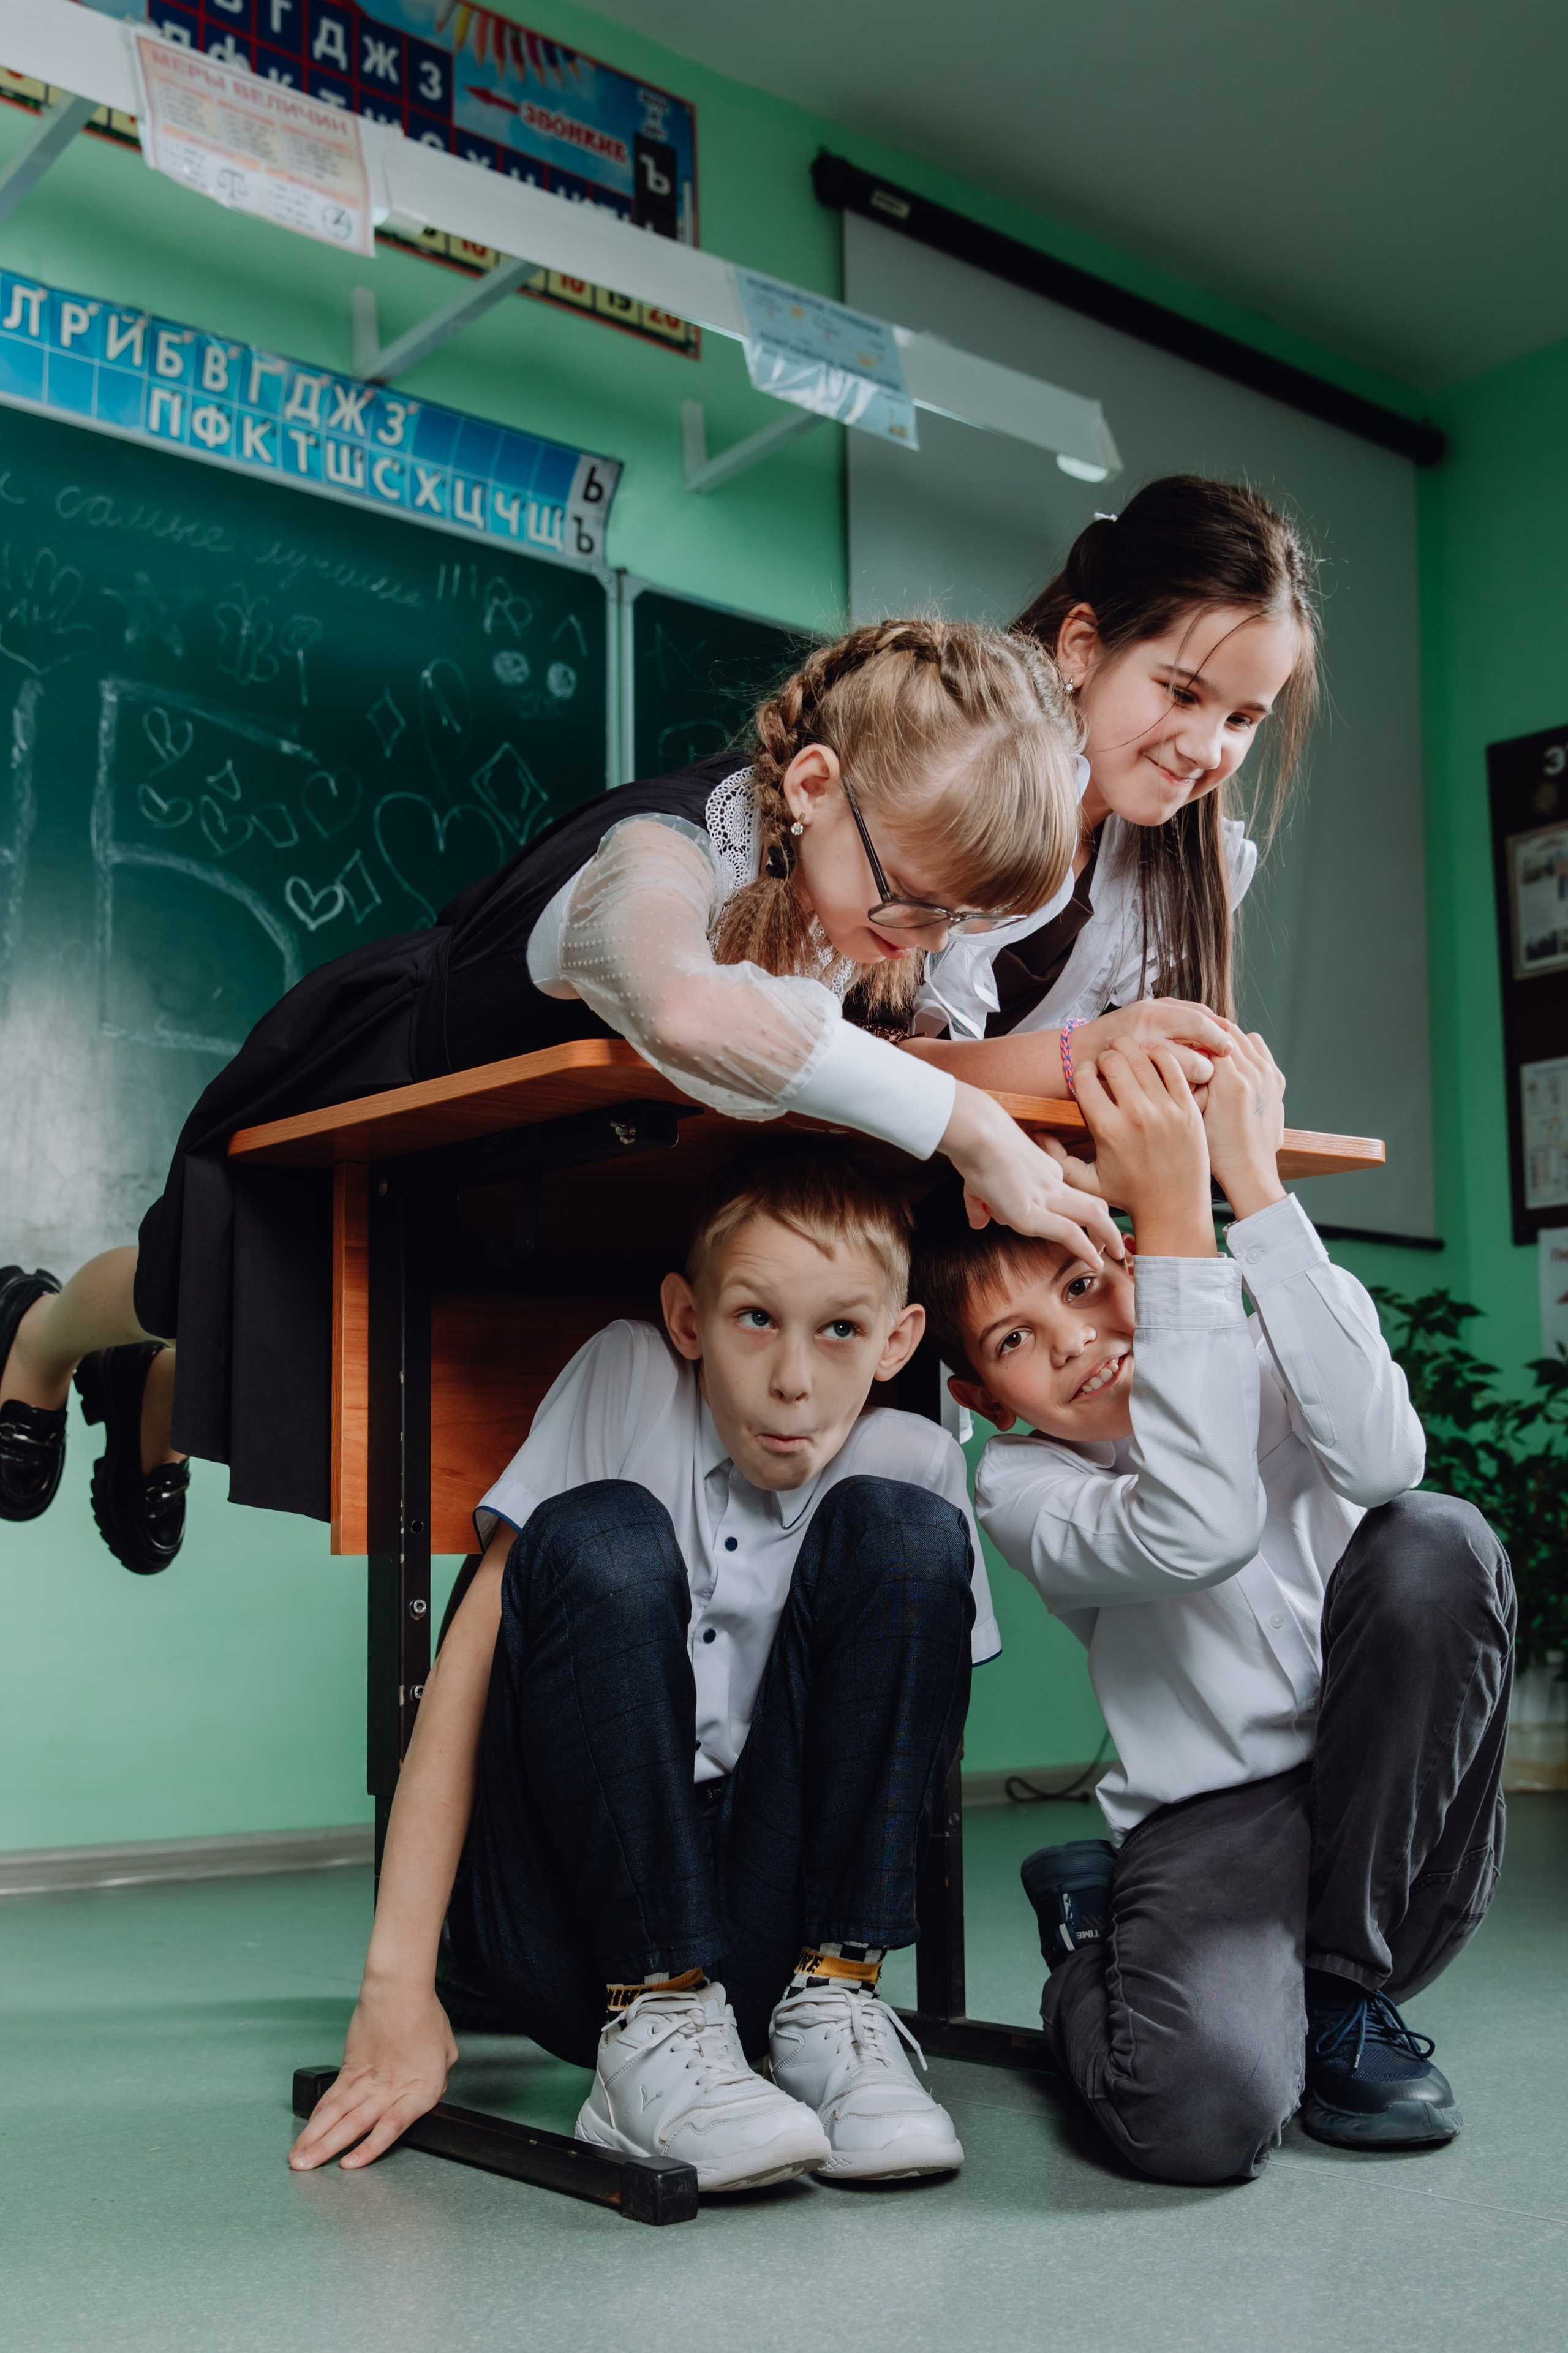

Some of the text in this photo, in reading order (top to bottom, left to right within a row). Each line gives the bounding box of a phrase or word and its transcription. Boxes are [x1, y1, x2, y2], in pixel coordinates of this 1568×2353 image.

[313, 17, 348, 71] Д
[362, 34, 399, 85] Ж
[2, 284, 40, 337] Л
[61, 302, 90, 347] Р
[156, 330, 189, 378] Б
[202, 345, 229, 393] В
[285, 372, 322, 428] Д
[327, 384, 371, 436] Ж
[149, 387, 183, 438] П
[191, 404, 232, 448] Ф
[243, 415, 274, 464] К
[288, 429, 317, 474] Т
[326, 440, 365, 489] Ш
[453, 478, 485, 531] Ц
[494, 491, 521, 536] Ч
[527, 502, 564, 551] Щ
[1076, 1929, 1101, 1940] TIME
